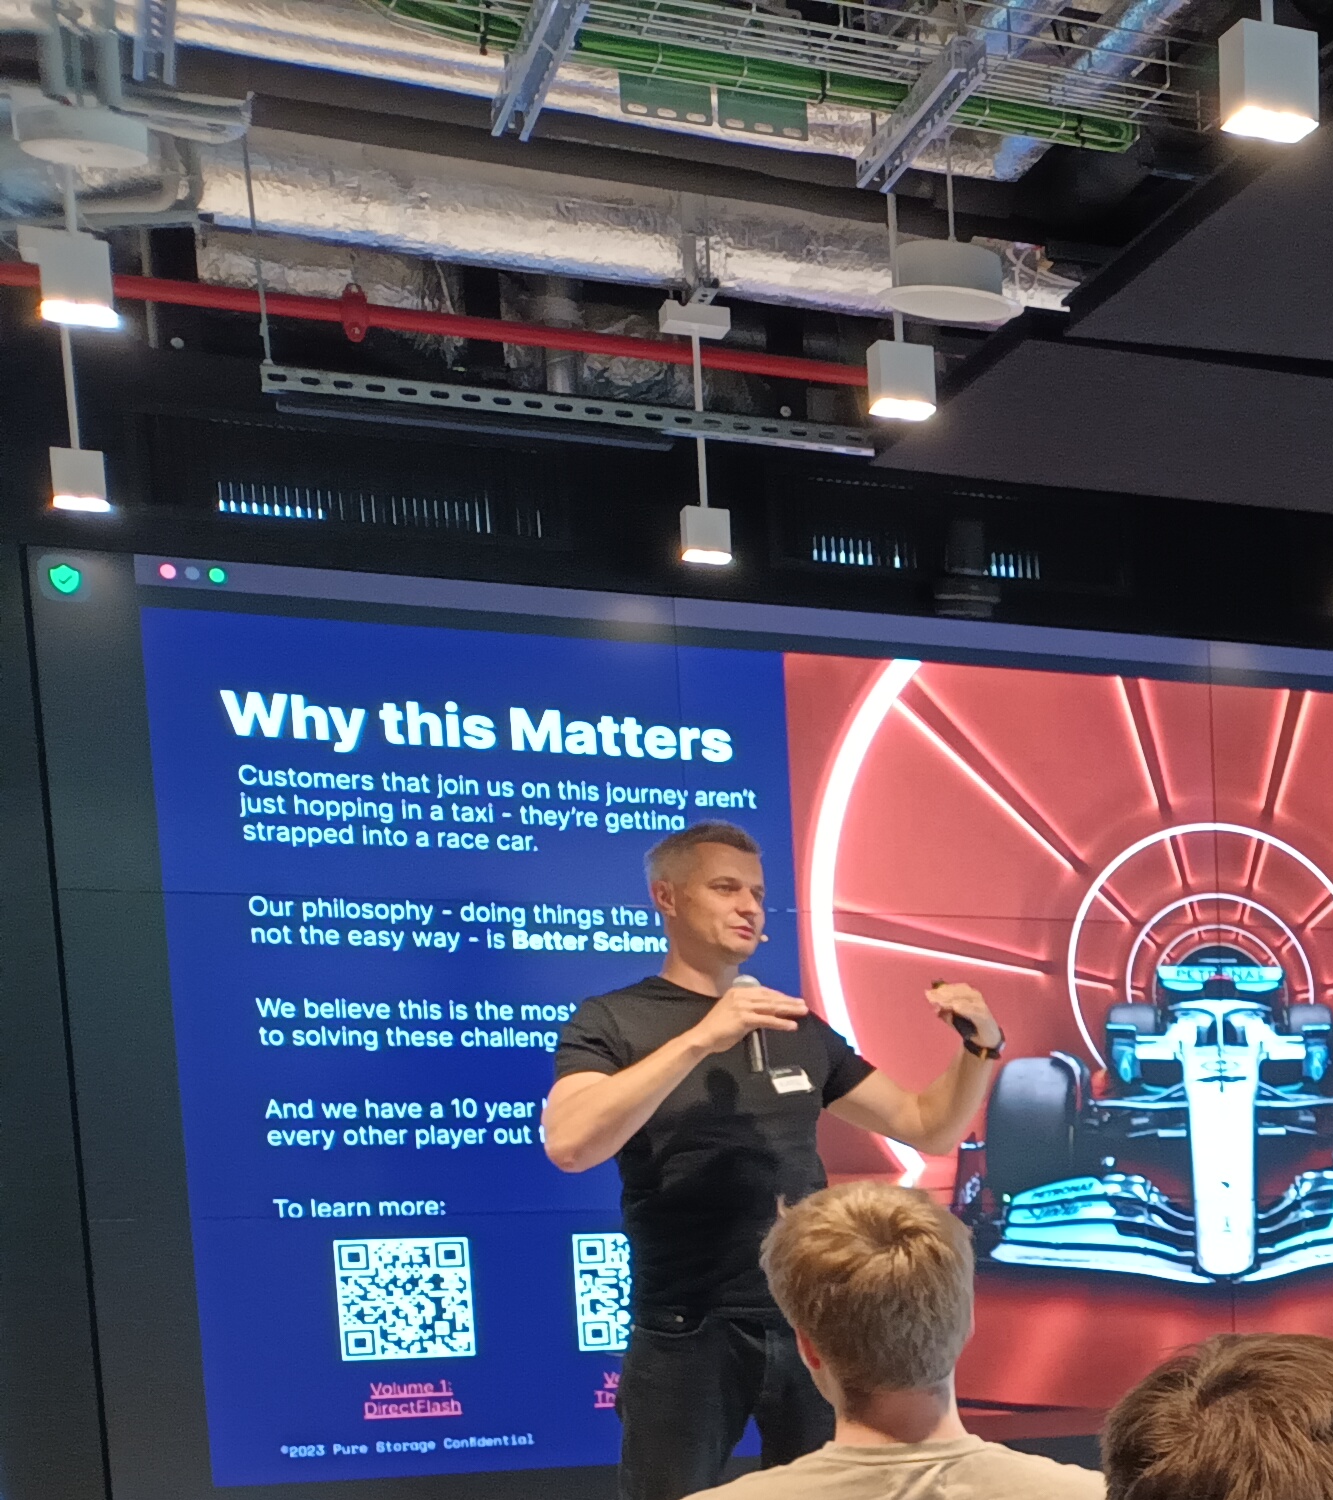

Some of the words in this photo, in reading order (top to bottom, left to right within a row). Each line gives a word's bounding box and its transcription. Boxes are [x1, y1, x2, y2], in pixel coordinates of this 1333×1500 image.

[219, 689, 366, 754] Why
[378, 700, 497, 750] this
[509, 706, 733, 763] Matters
[238, 764, 374, 792] Customers
[381, 771, 431, 794] that
[436, 773, 480, 799] join
[486, 780, 515, 798] us
[521, 781, 551, 800] on
[557, 779, 600, 802] this
[605, 781, 689, 811] journey
[694, 788, 757, 810] aren't
[239, 791, 287, 818] just
[293, 794, 394, 824] hopping
[401, 798, 423, 821] in
[429, 804, 444, 822] a
[451, 802, 494, 824] taxi
[519, 804, 599, 832] they're
[604, 809, 686, 834] getting
[242, 821, 355, 848] strapped
[362, 824, 408, 847] into
[415, 830, 430, 848] a
[437, 831, 490, 851] race
[496, 833, 539, 852] car.
[248, 895, 294, 917] Our
[301, 897, 434, 926] philosophy
[459, 901, 526, 929] doing
[532, 903, 605, 931] things
[610, 905, 649, 927] the
[250, 925, 293, 945] not
[298, 924, 340, 946] the
[347, 929, 405, 952] easy
[411, 930, 461, 953] way
[486, 928, 506, 950] is
[511, 928, 589, 952] Better
[255, 997, 297, 1019] We
[303, 997, 391, 1020] believe
[397, 999, 442, 1021] this
[448, 999, 469, 1021] is
[474, 999, 514, 1021] the
[258, 1026, 285, 1047] to
[291, 1025, 379, 1052] solving
[385, 1026, 454, 1048] these
[460, 1026, 559, 1053] challeng
[265, 1098, 314, 1120] And
[321, 1102, 358, 1120] we
[364, 1098, 423, 1119] have
[429, 1102, 444, 1119] a
[450, 1097, 478, 1119] 10
[484, 1101, 536, 1123] year
[266, 1129, 336, 1151] every
[343, 1124, 408, 1146] other
[415, 1124, 487, 1150] player
[493, 1124, 533, 1145] out
[272, 1198, 304, 1219] To
[310, 1198, 371, 1218] learn
[378, 1200, 446, 1217] more:
[370, 1381, 434, 1397] Volume
[364, 1399, 462, 1417] DirectFlash
[332, 1443, 369, 1455] Pure
[375, 1440, 436, 1454] Storage
[443, 1433, 535, 1450] Confidential
